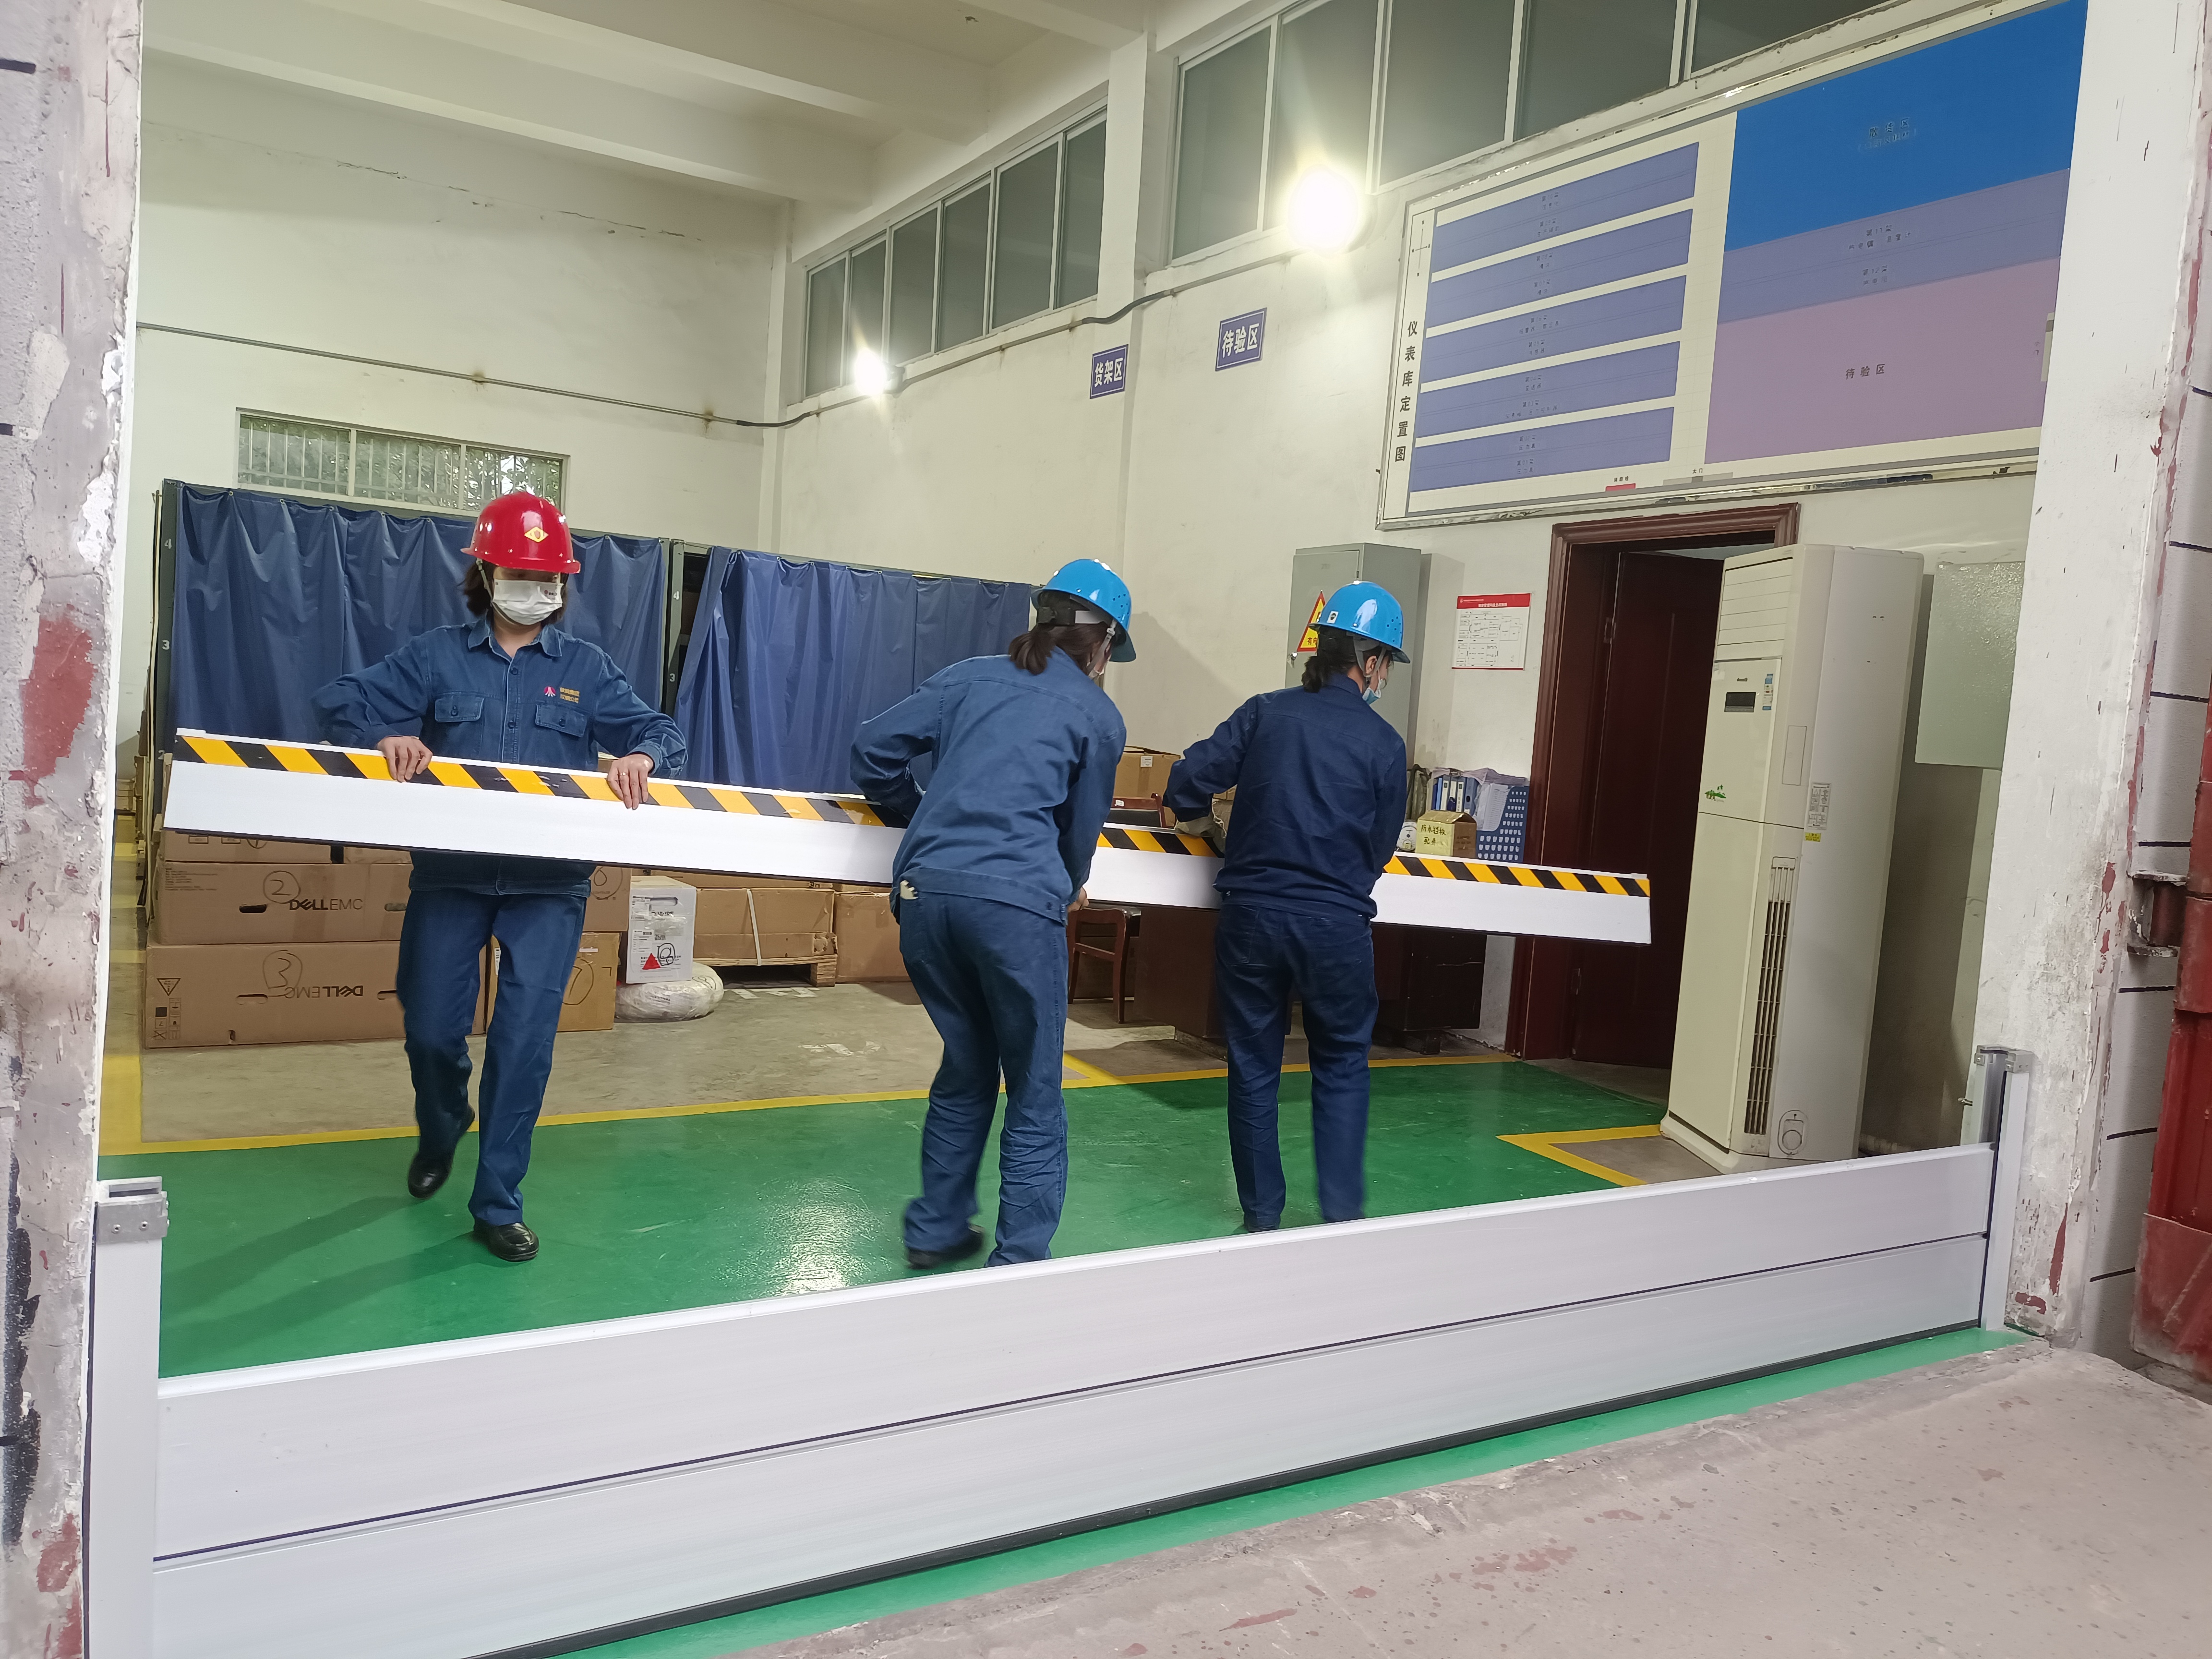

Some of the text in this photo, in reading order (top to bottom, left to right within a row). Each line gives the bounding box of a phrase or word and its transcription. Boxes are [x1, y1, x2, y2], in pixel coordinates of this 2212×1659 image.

[1222, 323, 1260, 358] 待验区
[1094, 357, 1123, 387] 货架区
[1845, 363, 1885, 380] 待验区
[1395, 321, 1418, 462] 仪表库定置图
[164, 538, 172, 549] 4
[673, 590, 680, 601] 4
[162, 639, 170, 650] 3
[669, 673, 676, 683] 3
